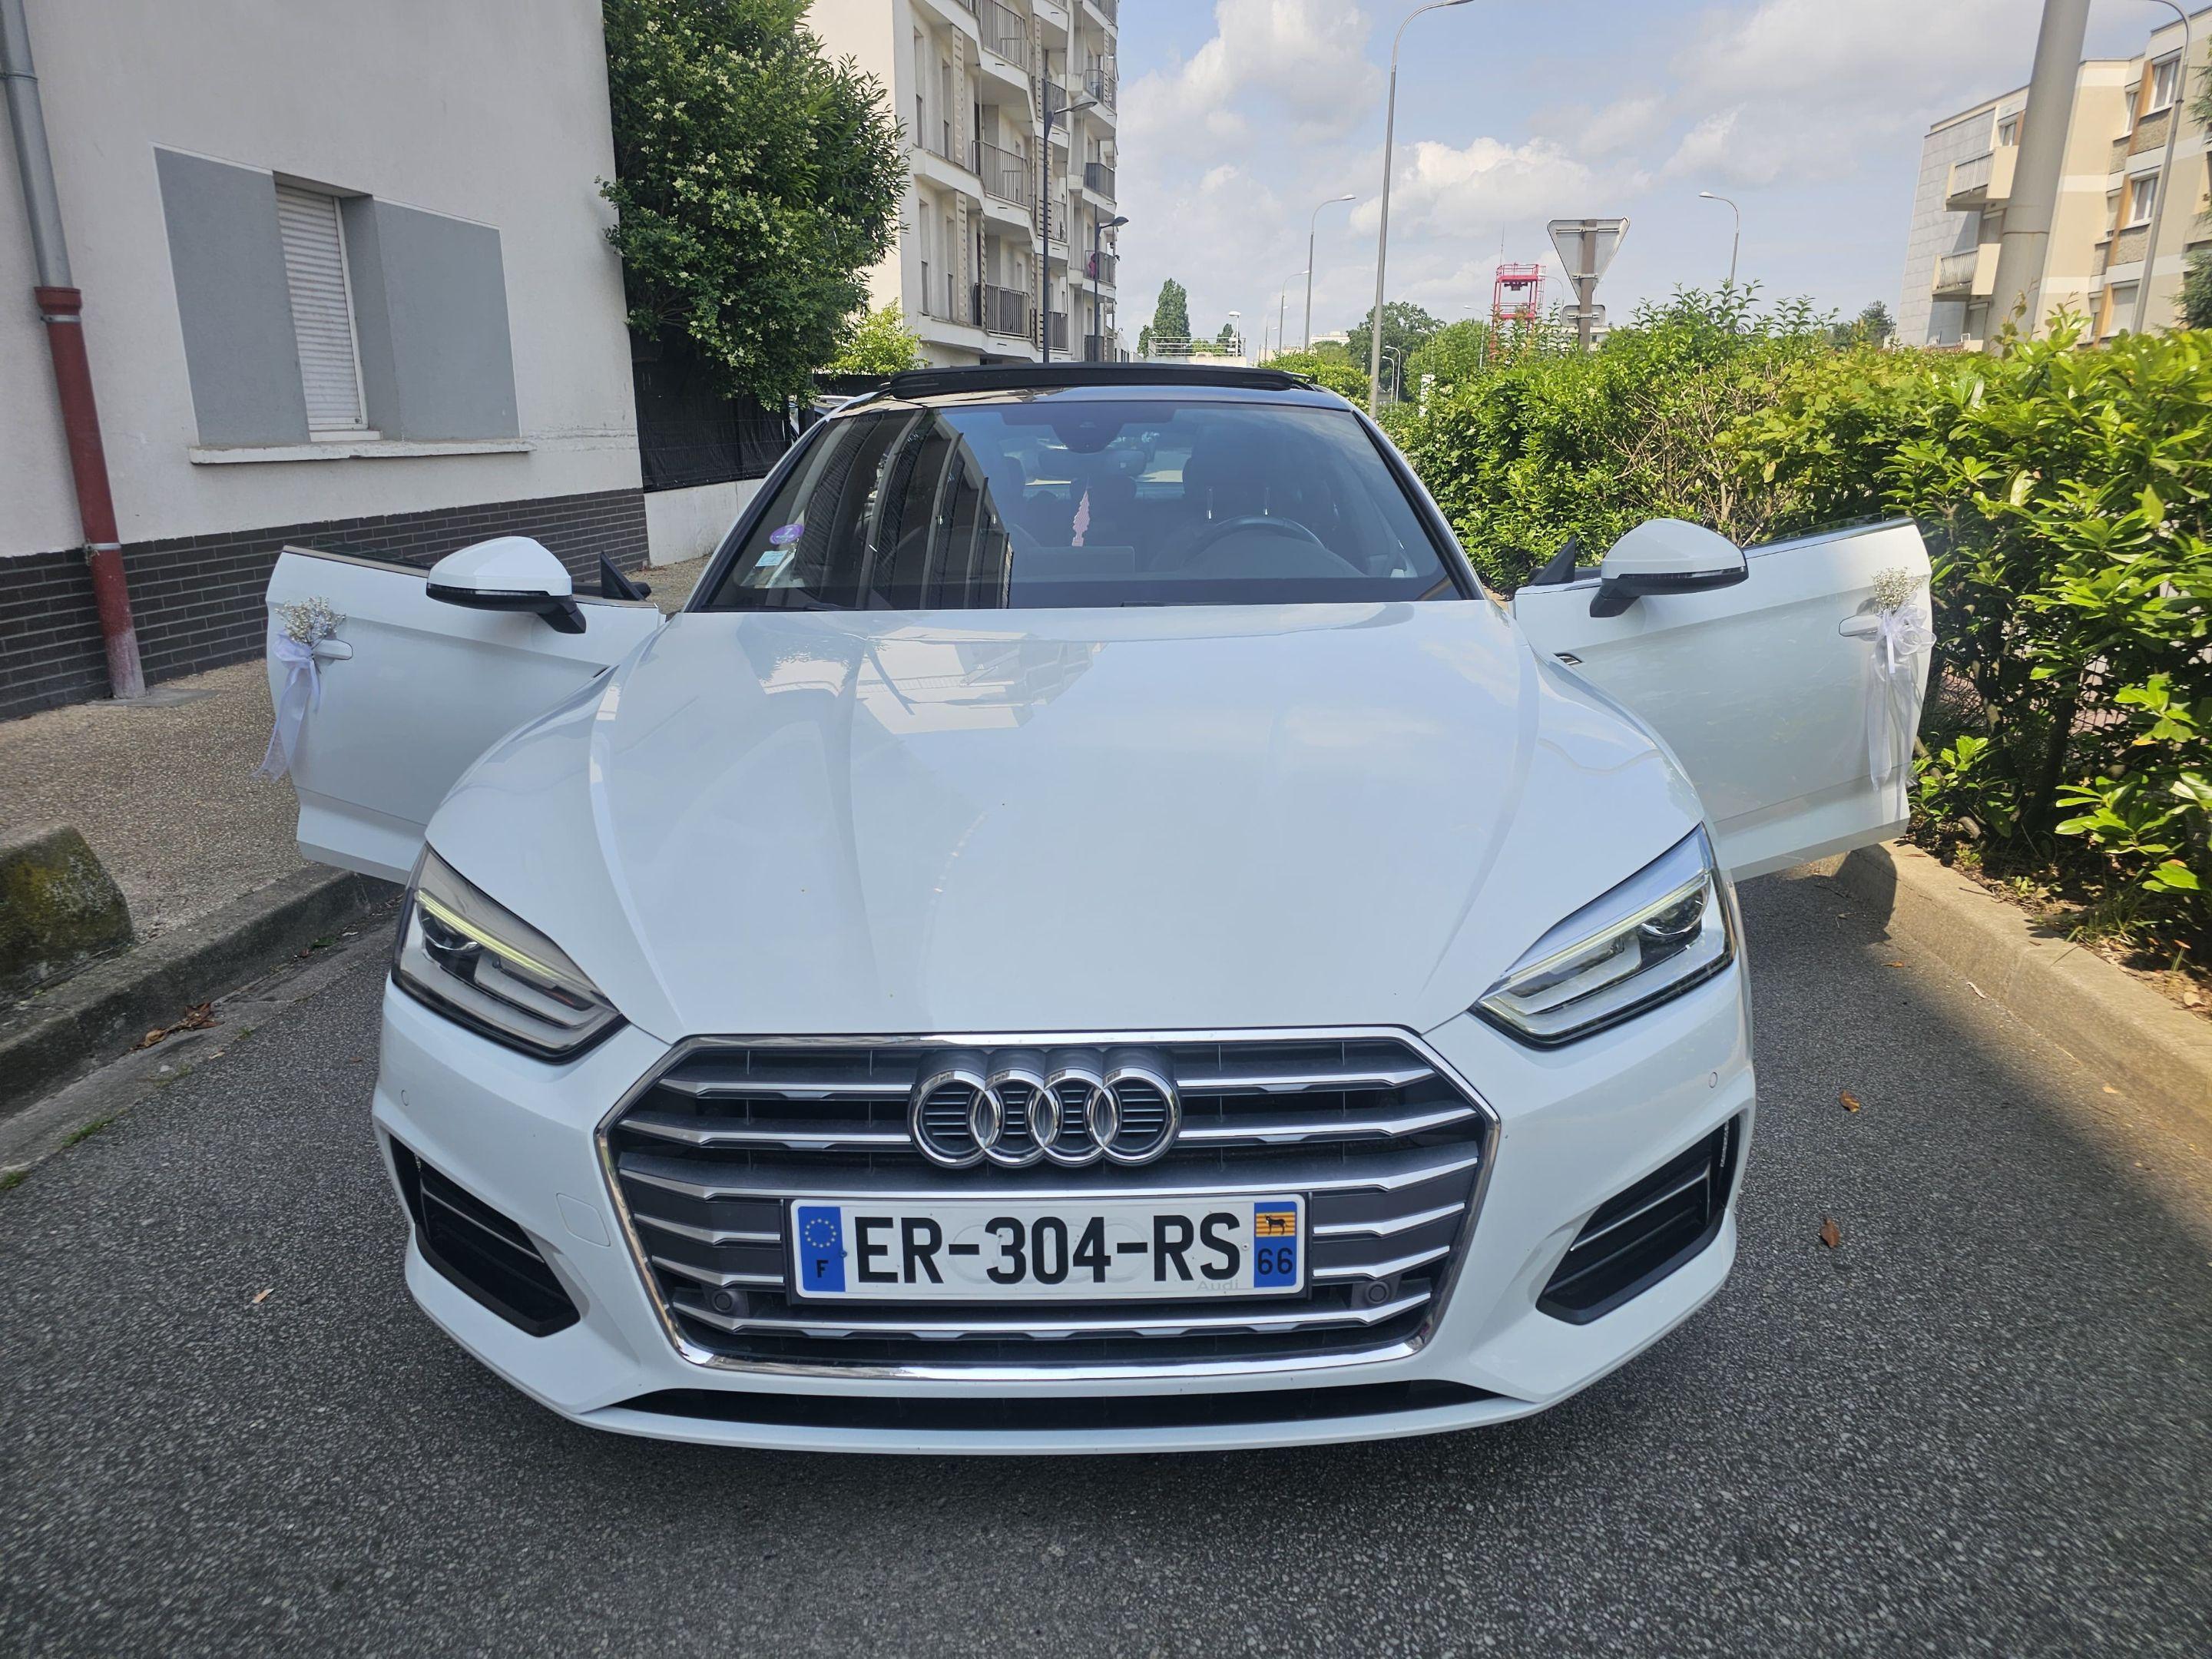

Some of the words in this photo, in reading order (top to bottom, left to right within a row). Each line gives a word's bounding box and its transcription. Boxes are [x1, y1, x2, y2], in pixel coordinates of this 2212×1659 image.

[855, 1212, 1240, 1285] ER-304-RS
[816, 1260, 829, 1278] F
[1257, 1247, 1293, 1275] 66
[1196, 1279, 1239, 1291] Audi
